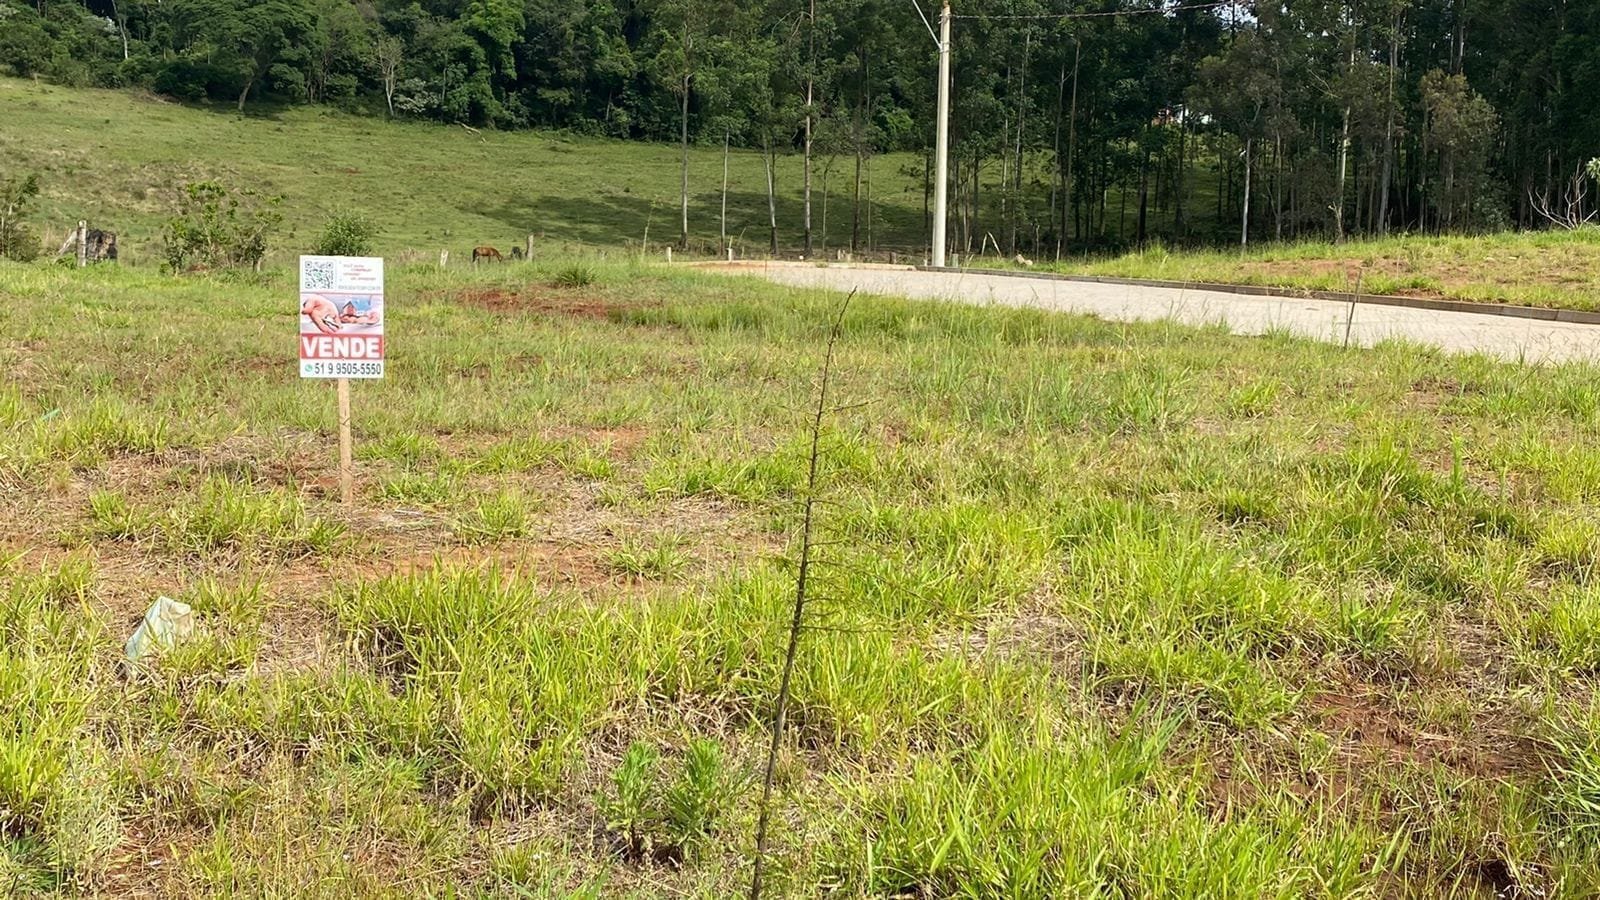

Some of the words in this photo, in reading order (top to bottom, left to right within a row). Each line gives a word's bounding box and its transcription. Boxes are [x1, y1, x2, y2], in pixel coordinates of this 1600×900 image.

[302, 336, 380, 358] VENDE
[314, 362, 325, 375] 51
[328, 362, 333, 375] 9
[336, 362, 381, 375] 9505-5550
